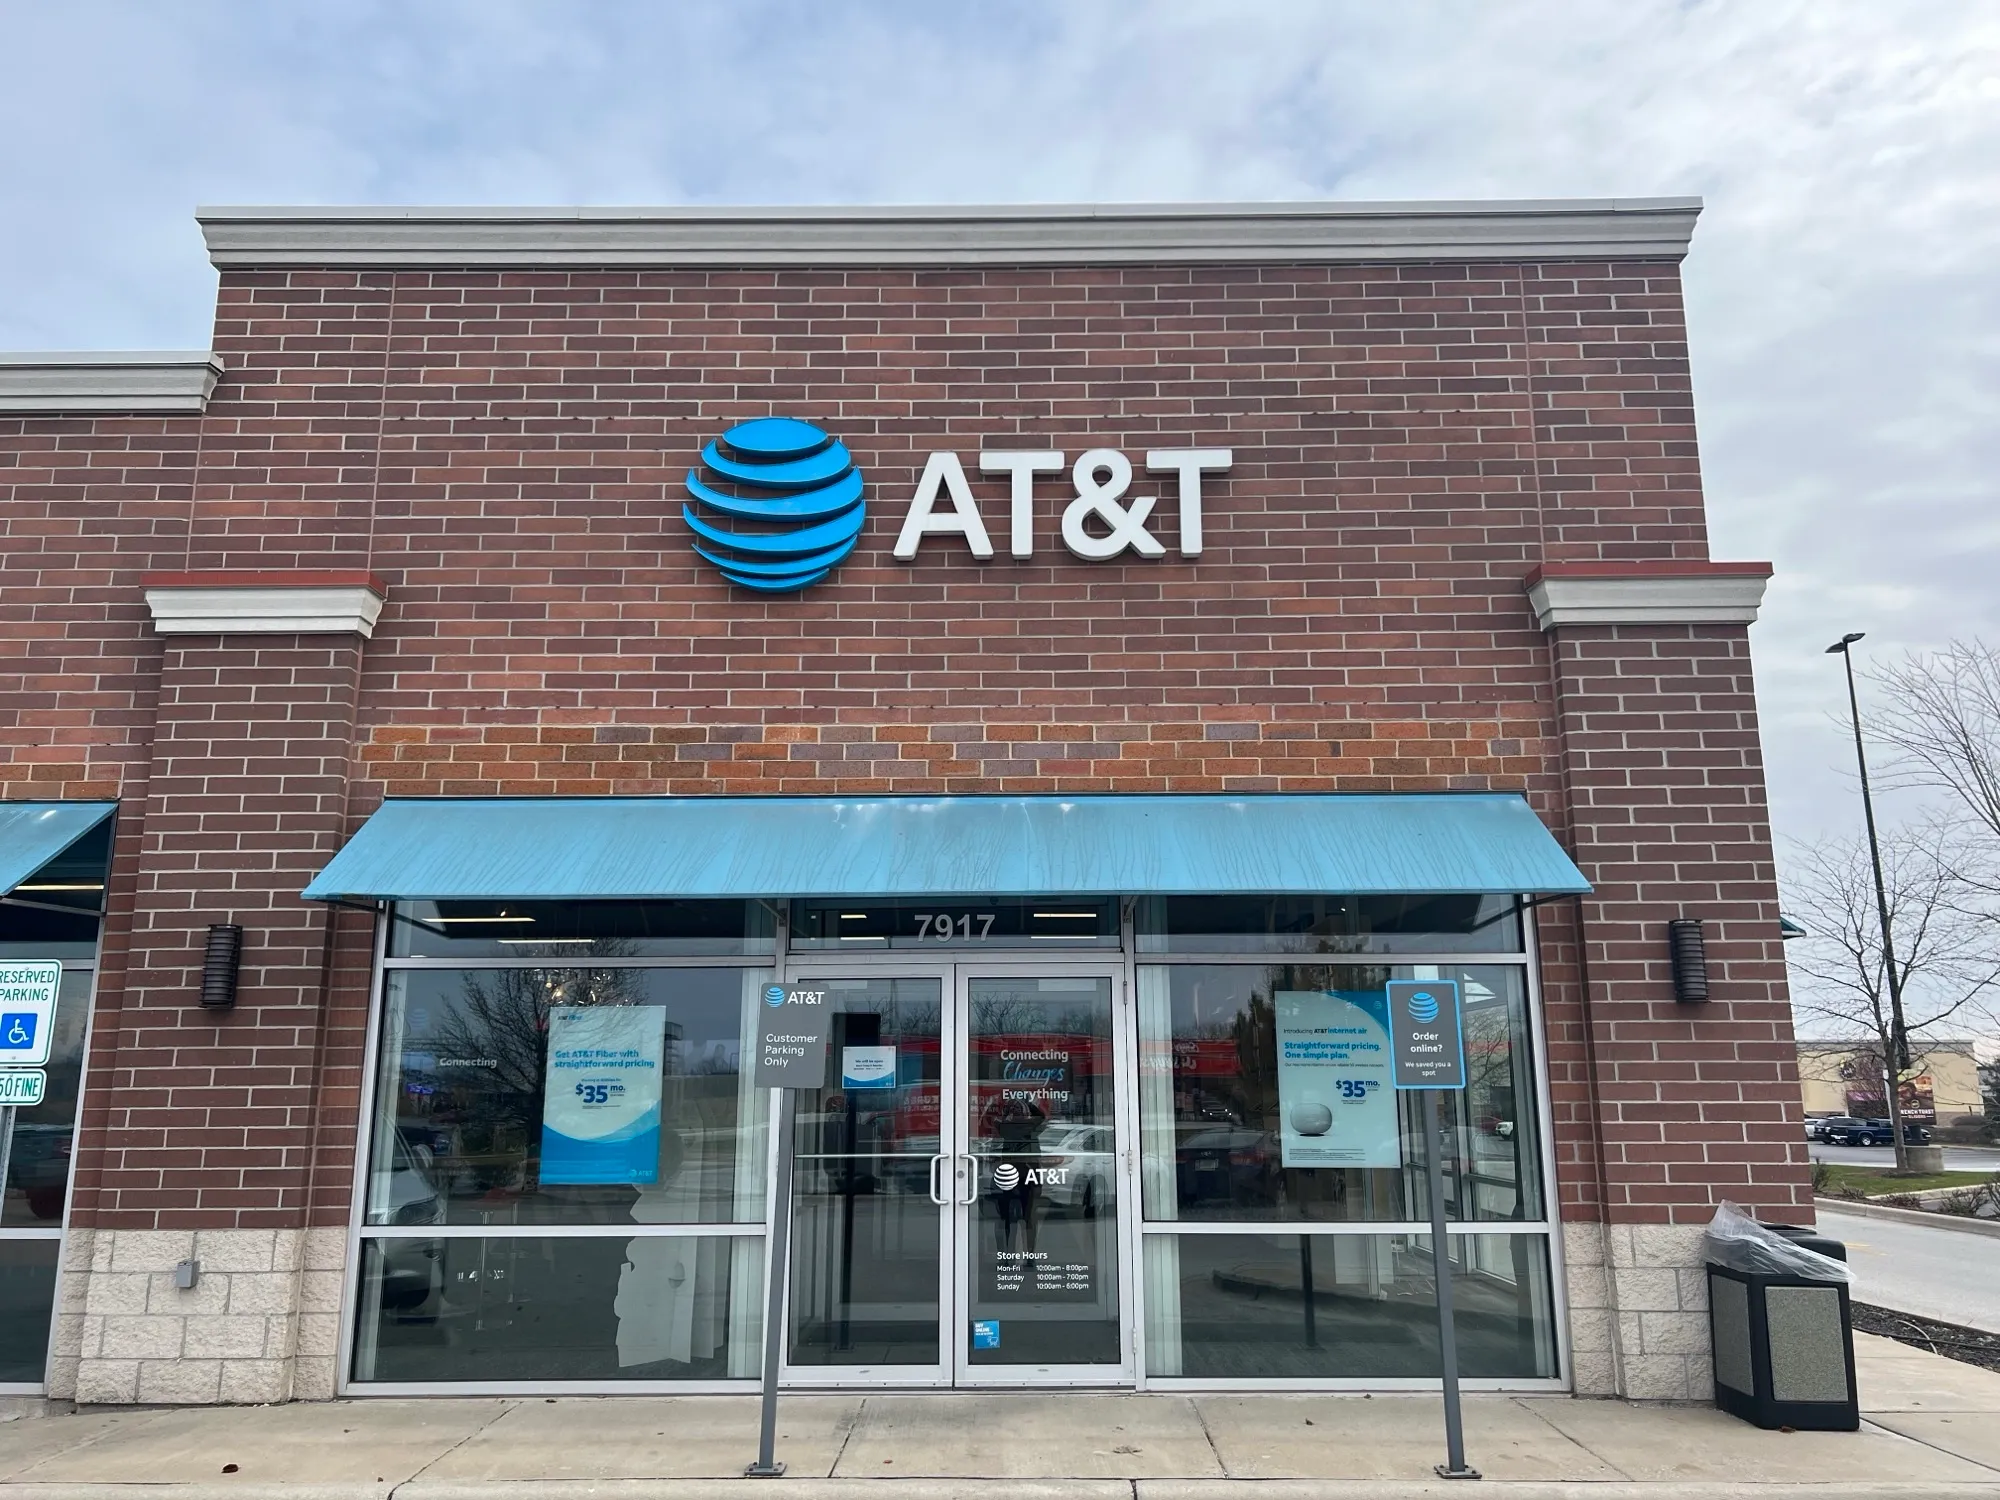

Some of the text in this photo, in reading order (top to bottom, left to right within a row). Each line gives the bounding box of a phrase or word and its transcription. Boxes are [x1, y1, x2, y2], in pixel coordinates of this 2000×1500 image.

[893, 448, 1233, 562] AT&T
[914, 913, 996, 942] 7917
[0, 988, 49, 1001] PARKING
[787, 991, 825, 1005] AT&T
[1283, 1027, 1313, 1035] Introducing
[1328, 1026, 1356, 1034] internet
[766, 1034, 818, 1043] Customer
[1412, 1032, 1439, 1041] Order
[765, 1045, 805, 1056] Parking
[1284, 1042, 1382, 1051] Straightforward pricing.
[1410, 1044, 1443, 1053] online?
[555, 1049, 640, 1059] Get AT&T Fiber with
[1000, 1049, 1069, 1062] Connecting
[1285, 1051, 1350, 1060] One simple plan.
[439, 1057, 498, 1069] Connecting
[554, 1060, 656, 1069] straightforward pricing
[764, 1057, 789, 1068] Only
[1003, 1061, 1065, 1086] Changes
[14, 1077, 40, 1097] FINE
[1336, 1079, 1366, 1098] $35
[575, 1083, 608, 1104] $35
[1003, 1088, 1070, 1103] Everything
[1024, 1168, 1069, 1185] AT&T
[997, 1251, 1048, 1260] Store Hours
[1036, 1264, 1061, 1272] 10:00am
[1065, 1264, 1089, 1272] 8:00pm
[997, 1274, 1025, 1282] Saturday
[1036, 1273, 1062, 1281] 10:00am
[1066, 1273, 1089, 1282] 7:00pm
[997, 1283, 1020, 1291] Sunday
[1036, 1282, 1062, 1290] 10:00am
[1065, 1282, 1089, 1291] 6:00pm
